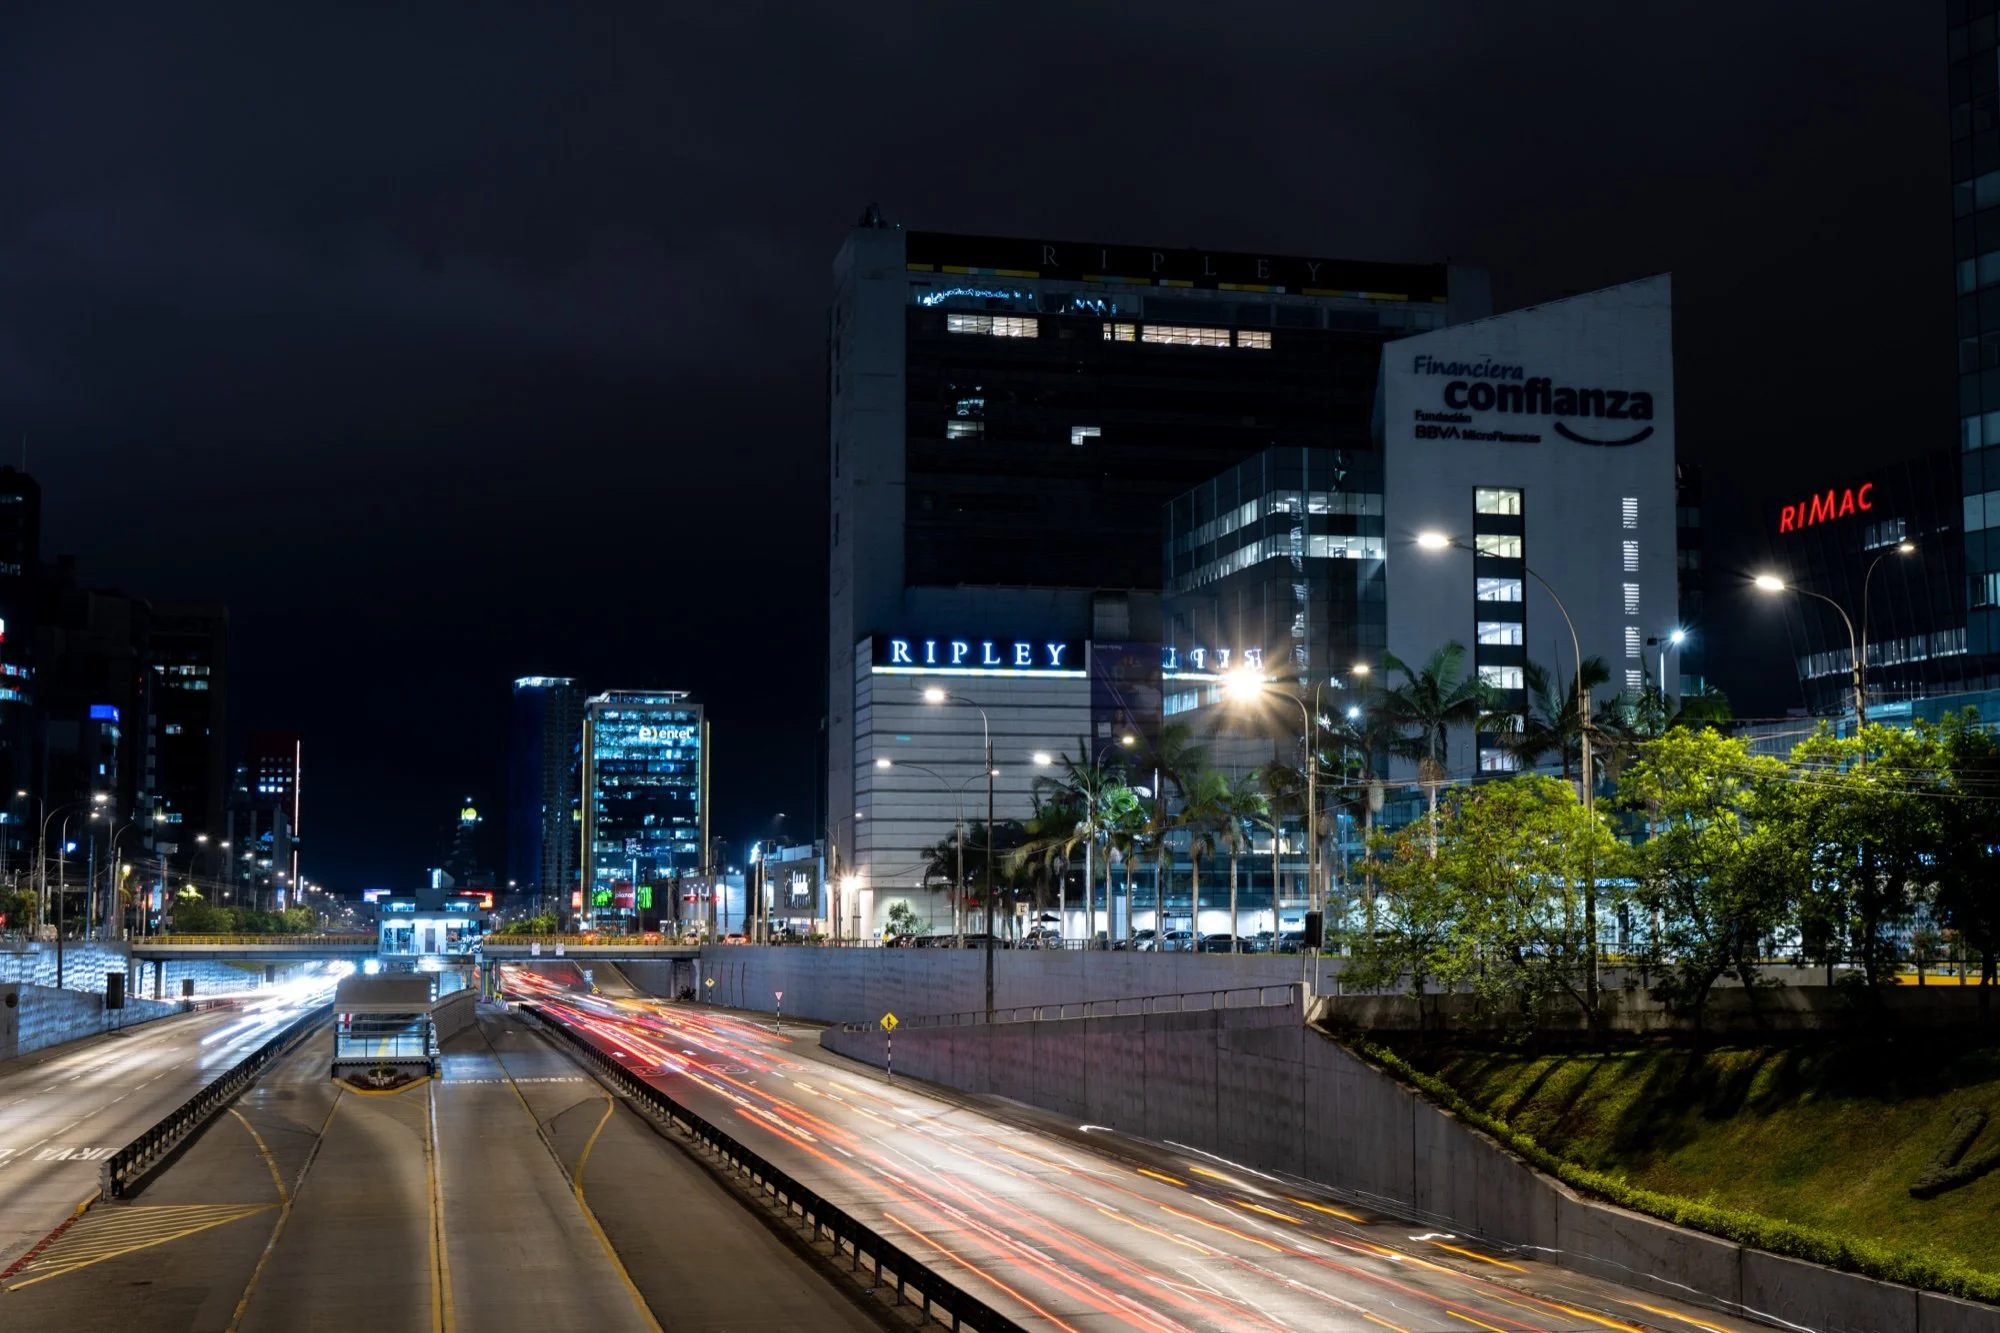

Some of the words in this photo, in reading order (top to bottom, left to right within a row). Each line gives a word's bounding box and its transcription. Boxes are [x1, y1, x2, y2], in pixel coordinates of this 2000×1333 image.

[1041, 244, 1322, 283] RIPLEY
[1413, 355, 1524, 381] Financiera
[1444, 377, 1653, 420] confianza
[1415, 425, 1460, 440] BBVA
[1779, 481, 1873, 535] RIMAC
[892, 640, 1066, 665] RIPLEY
